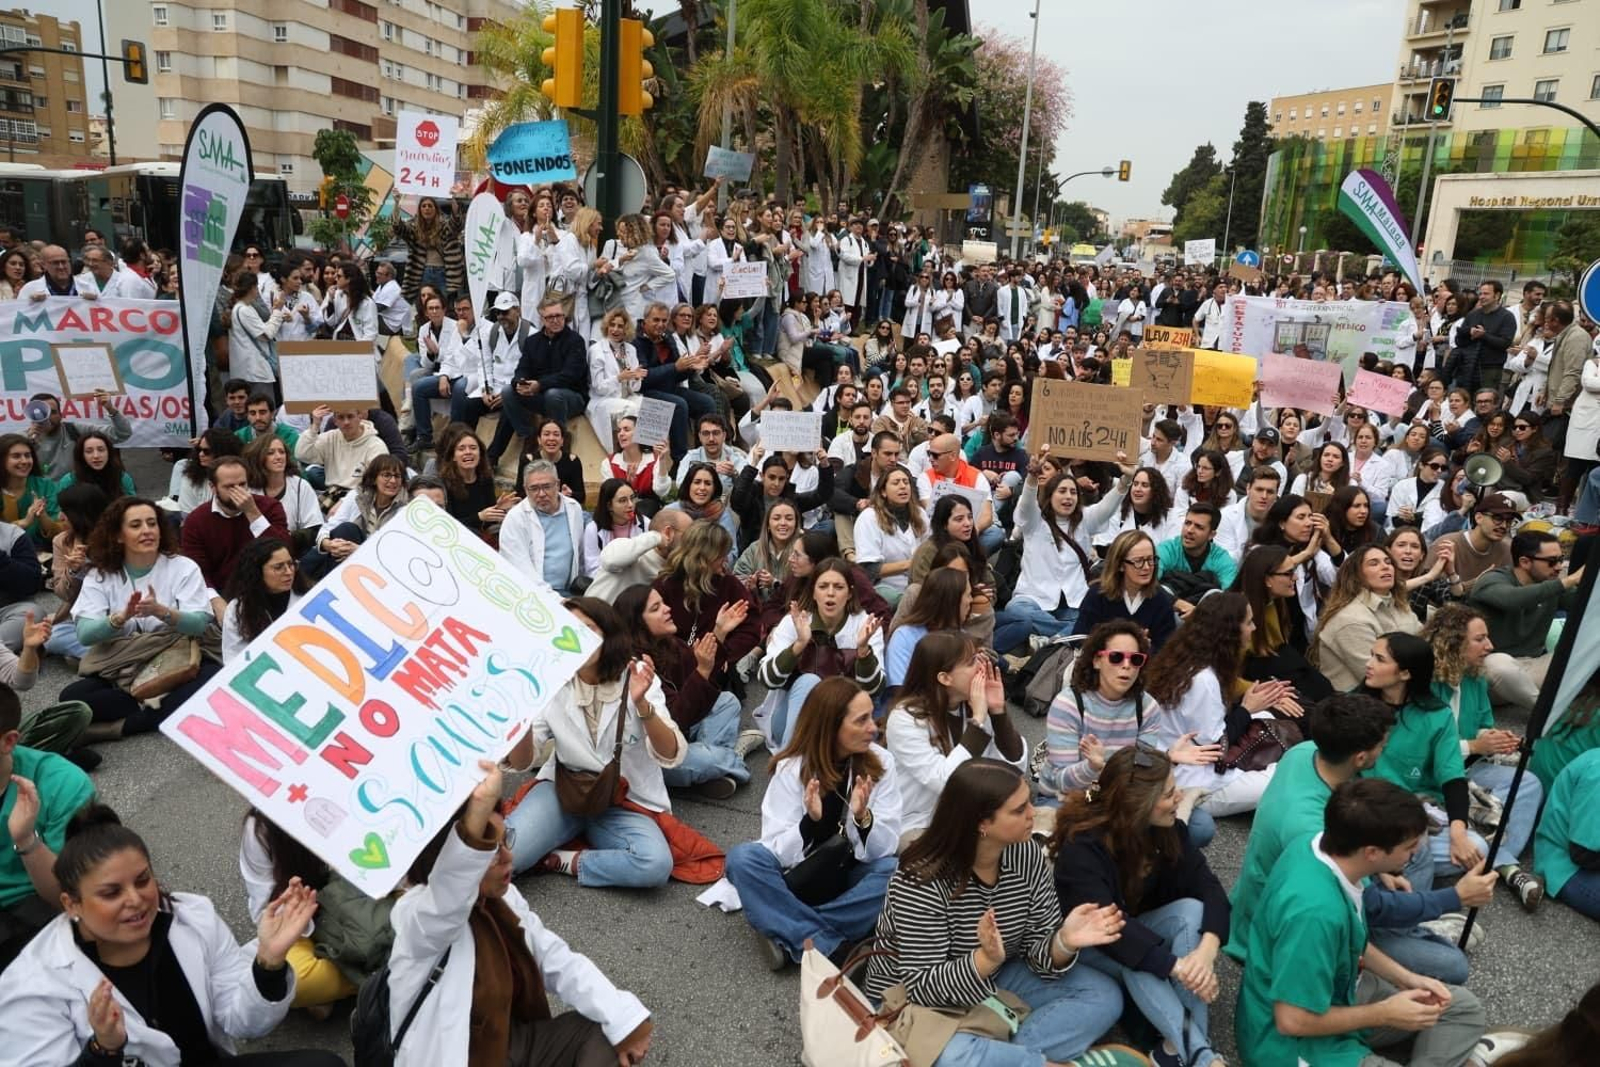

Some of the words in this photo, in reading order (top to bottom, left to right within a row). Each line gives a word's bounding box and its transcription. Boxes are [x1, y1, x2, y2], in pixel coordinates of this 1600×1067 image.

[416, 130, 440, 141] STOP
[198, 128, 245, 171] SMA
[493, 154, 572, 177] FONENDOS
[1353, 181, 1379, 216] SMA
[12, 306, 180, 335] MARCO
[1171, 332, 1190, 346] 23H
[164, 421, 190, 436] SMA
[1049, 426, 1066, 445] NO
[1068, 428, 1076, 447] A
[1078, 430, 1093, 448] LAS
[1095, 426, 1128, 449] 24H
[177, 529, 460, 798] MÉDIC@
[319, 698, 400, 780] NO
[391, 616, 492, 711] MATA
